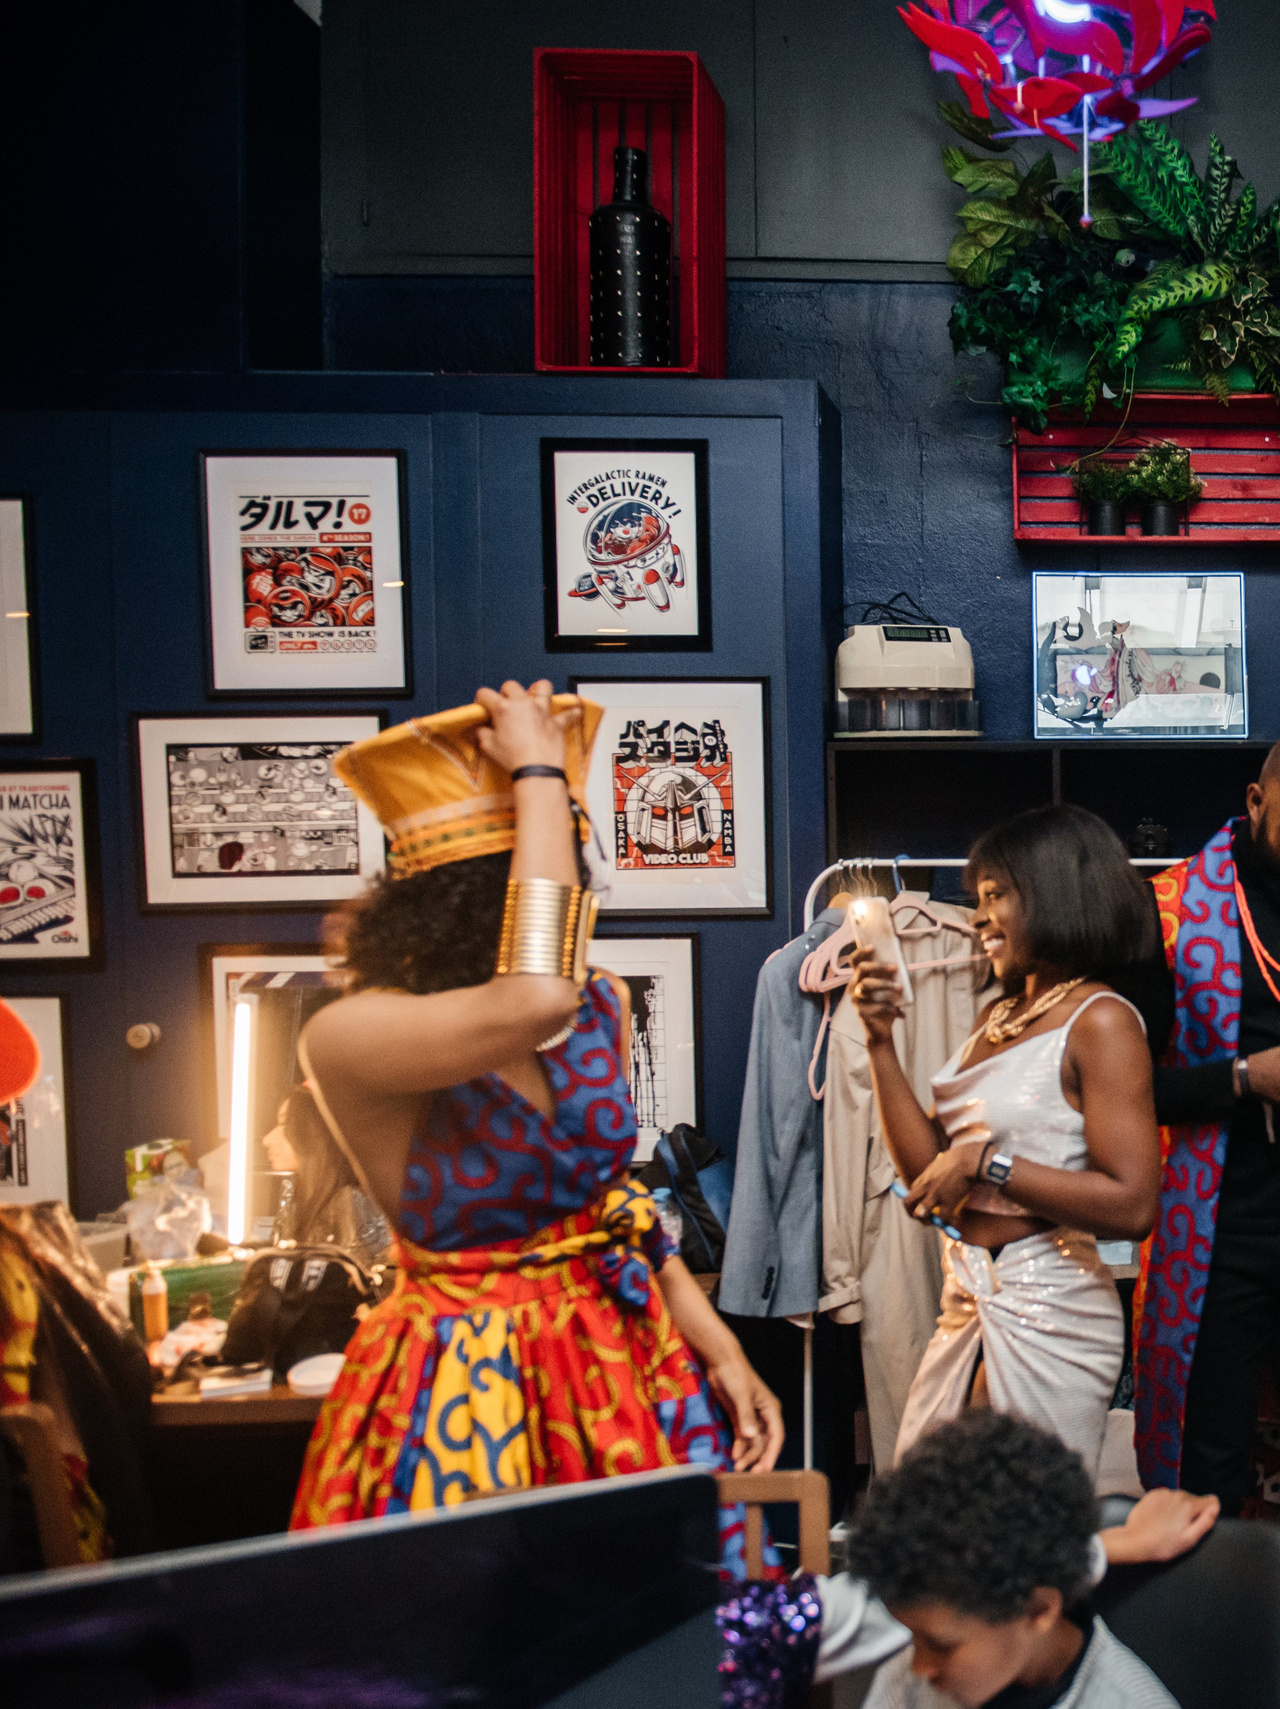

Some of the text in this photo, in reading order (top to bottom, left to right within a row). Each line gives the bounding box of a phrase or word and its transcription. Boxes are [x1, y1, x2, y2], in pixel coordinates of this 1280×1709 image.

[566, 469, 668, 506] INTERGALACTIC RAMEN
[585, 480, 682, 519] DELIVERY!
[351, 508, 367, 520] 17
[279, 631, 294, 639] THE
[307, 630, 334, 638] SHOW
[337, 630, 346, 638] IS
[9, 793, 71, 811] MATCHA
[617, 813, 627, 856] OSAKA
[723, 813, 733, 852] NAMBA
[643, 853, 709, 865] VIDEO CLUB
